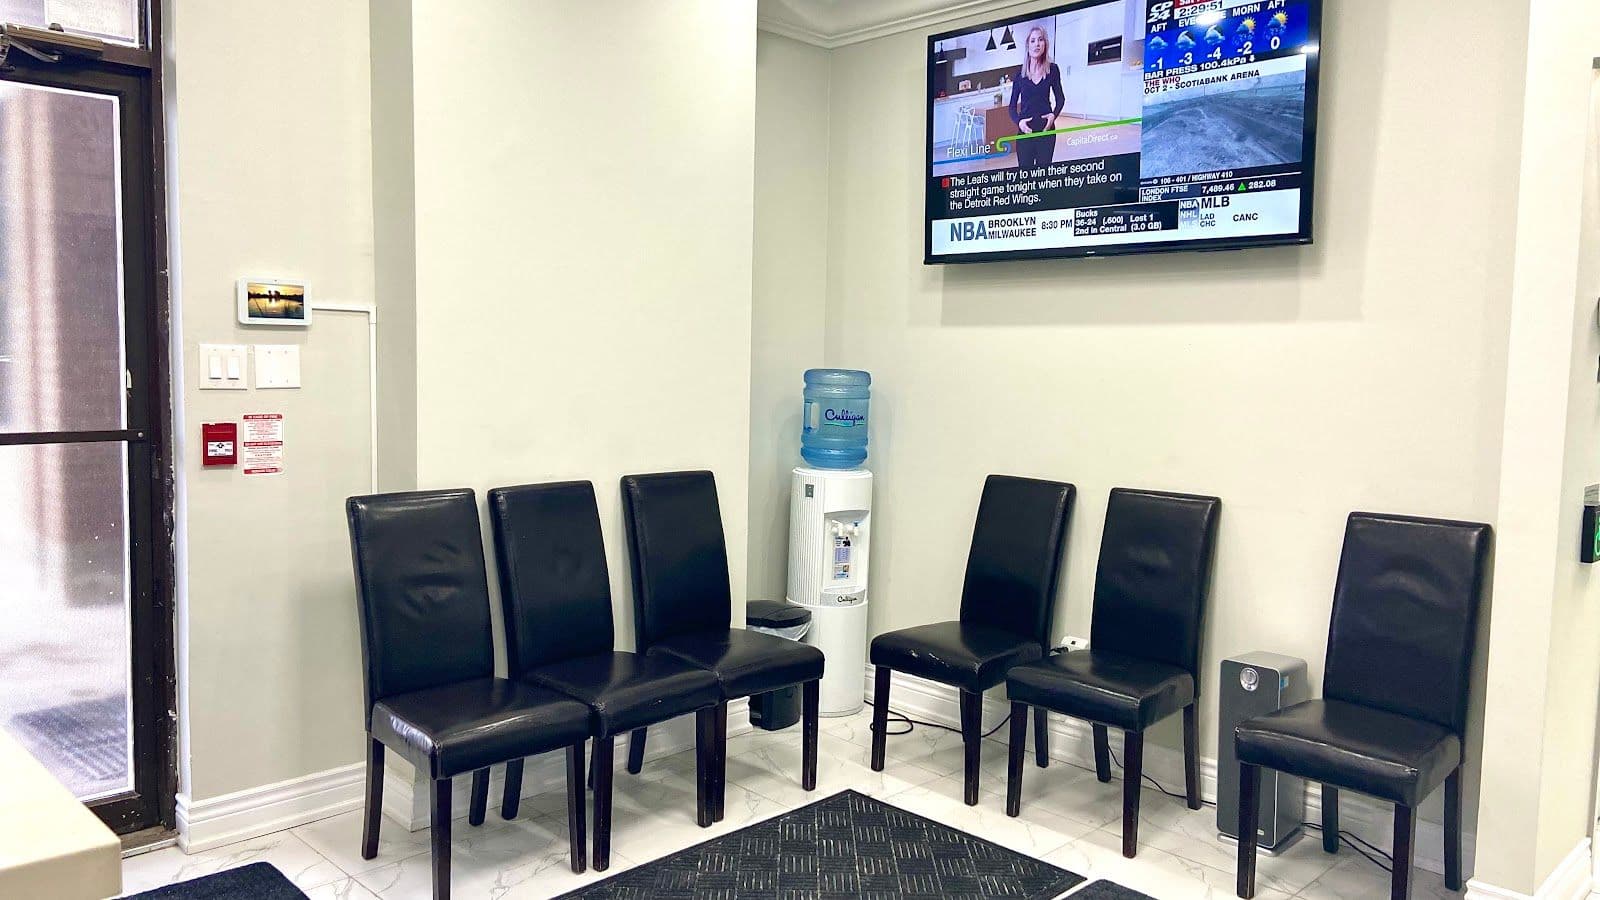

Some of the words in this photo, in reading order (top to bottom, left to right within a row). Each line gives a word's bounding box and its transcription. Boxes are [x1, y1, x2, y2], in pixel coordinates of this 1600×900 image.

[1150, 1, 1173, 12] CP
[1180, 2, 1223, 17] 2:29:51
[1147, 10, 1170, 23] 24
[1151, 22, 1167, 33] AFT
[1179, 17, 1196, 27] EVE
[1232, 4, 1260, 16] MORN
[1268, 0, 1286, 9] AFT
[1151, 57, 1163, 69] -1
[1179, 52, 1193, 65] -3
[1207, 47, 1222, 59] -4
[1237, 42, 1252, 55] -2
[1270, 36, 1280, 50] 0
[1145, 71, 1164, 80] BAR
[1166, 64, 1197, 77] PRESS
[1200, 56, 1246, 71] 100.4kPa
[1145, 79, 1159, 88] THE
[1163, 76, 1180, 85] WHO
[1145, 86, 1160, 95] OCT
[1175, 75, 1228, 89] SCOTIABANK
[1231, 69, 1260, 81] ARENA
[947, 146, 968, 158] Flexi
[970, 143, 991, 155] Line
[950, 177, 965, 186] The
[967, 174, 989, 185] Leafs
[991, 171, 1004, 182] will
[1006, 171, 1018, 182] try
[1019, 170, 1028, 179] to
[1030, 167, 1045, 178] win
[1048, 164, 1068, 176] their
[1070, 159, 1105, 173] second
[1192, 172, 1220, 182] HIGHWAY
[950, 186, 980, 200] straight
[981, 185, 1005, 197] game
[1006, 181, 1036, 194] tonight
[1038, 179, 1062, 189] when
[1064, 176, 1085, 188] they
[1087, 173, 1107, 184] take
[1109, 173, 1122, 182] on
[1142, 186, 1170, 196] LONDON
[1171, 185, 1189, 193] FTSE
[950, 200, 962, 210] the
[965, 196, 991, 209] Detroit
[993, 194, 1010, 206] Red
[1012, 193, 1041, 205] Wings.
[1142, 194, 1162, 202] INDEX
[1180, 199, 1198, 209] NBA
[1201, 196, 1230, 209] MLB
[1075, 209, 1098, 218] Bucks
[1075, 218, 1097, 227] 36-24
[1130, 214, 1147, 223] Lost
[1149, 213, 1154, 221] 1
[1180, 210, 1198, 218] NHL
[1233, 213, 1259, 222] CANC
[988, 216, 1036, 229] BROOKLYN
[1041, 221, 1058, 230] 8:30
[1060, 219, 1073, 229] PM
[1075, 227, 1089, 235] 2nd
[1100, 224, 1126, 233] Central
[1131, 223, 1146, 232] (3.0
[1147, 221, 1162, 231] GB)
[1200, 220, 1216, 228] CHC
[951, 221, 988, 241] NBA
[988, 228, 1037, 239] MILWAUKEE
[825, 408, 864, 427] Culligan
